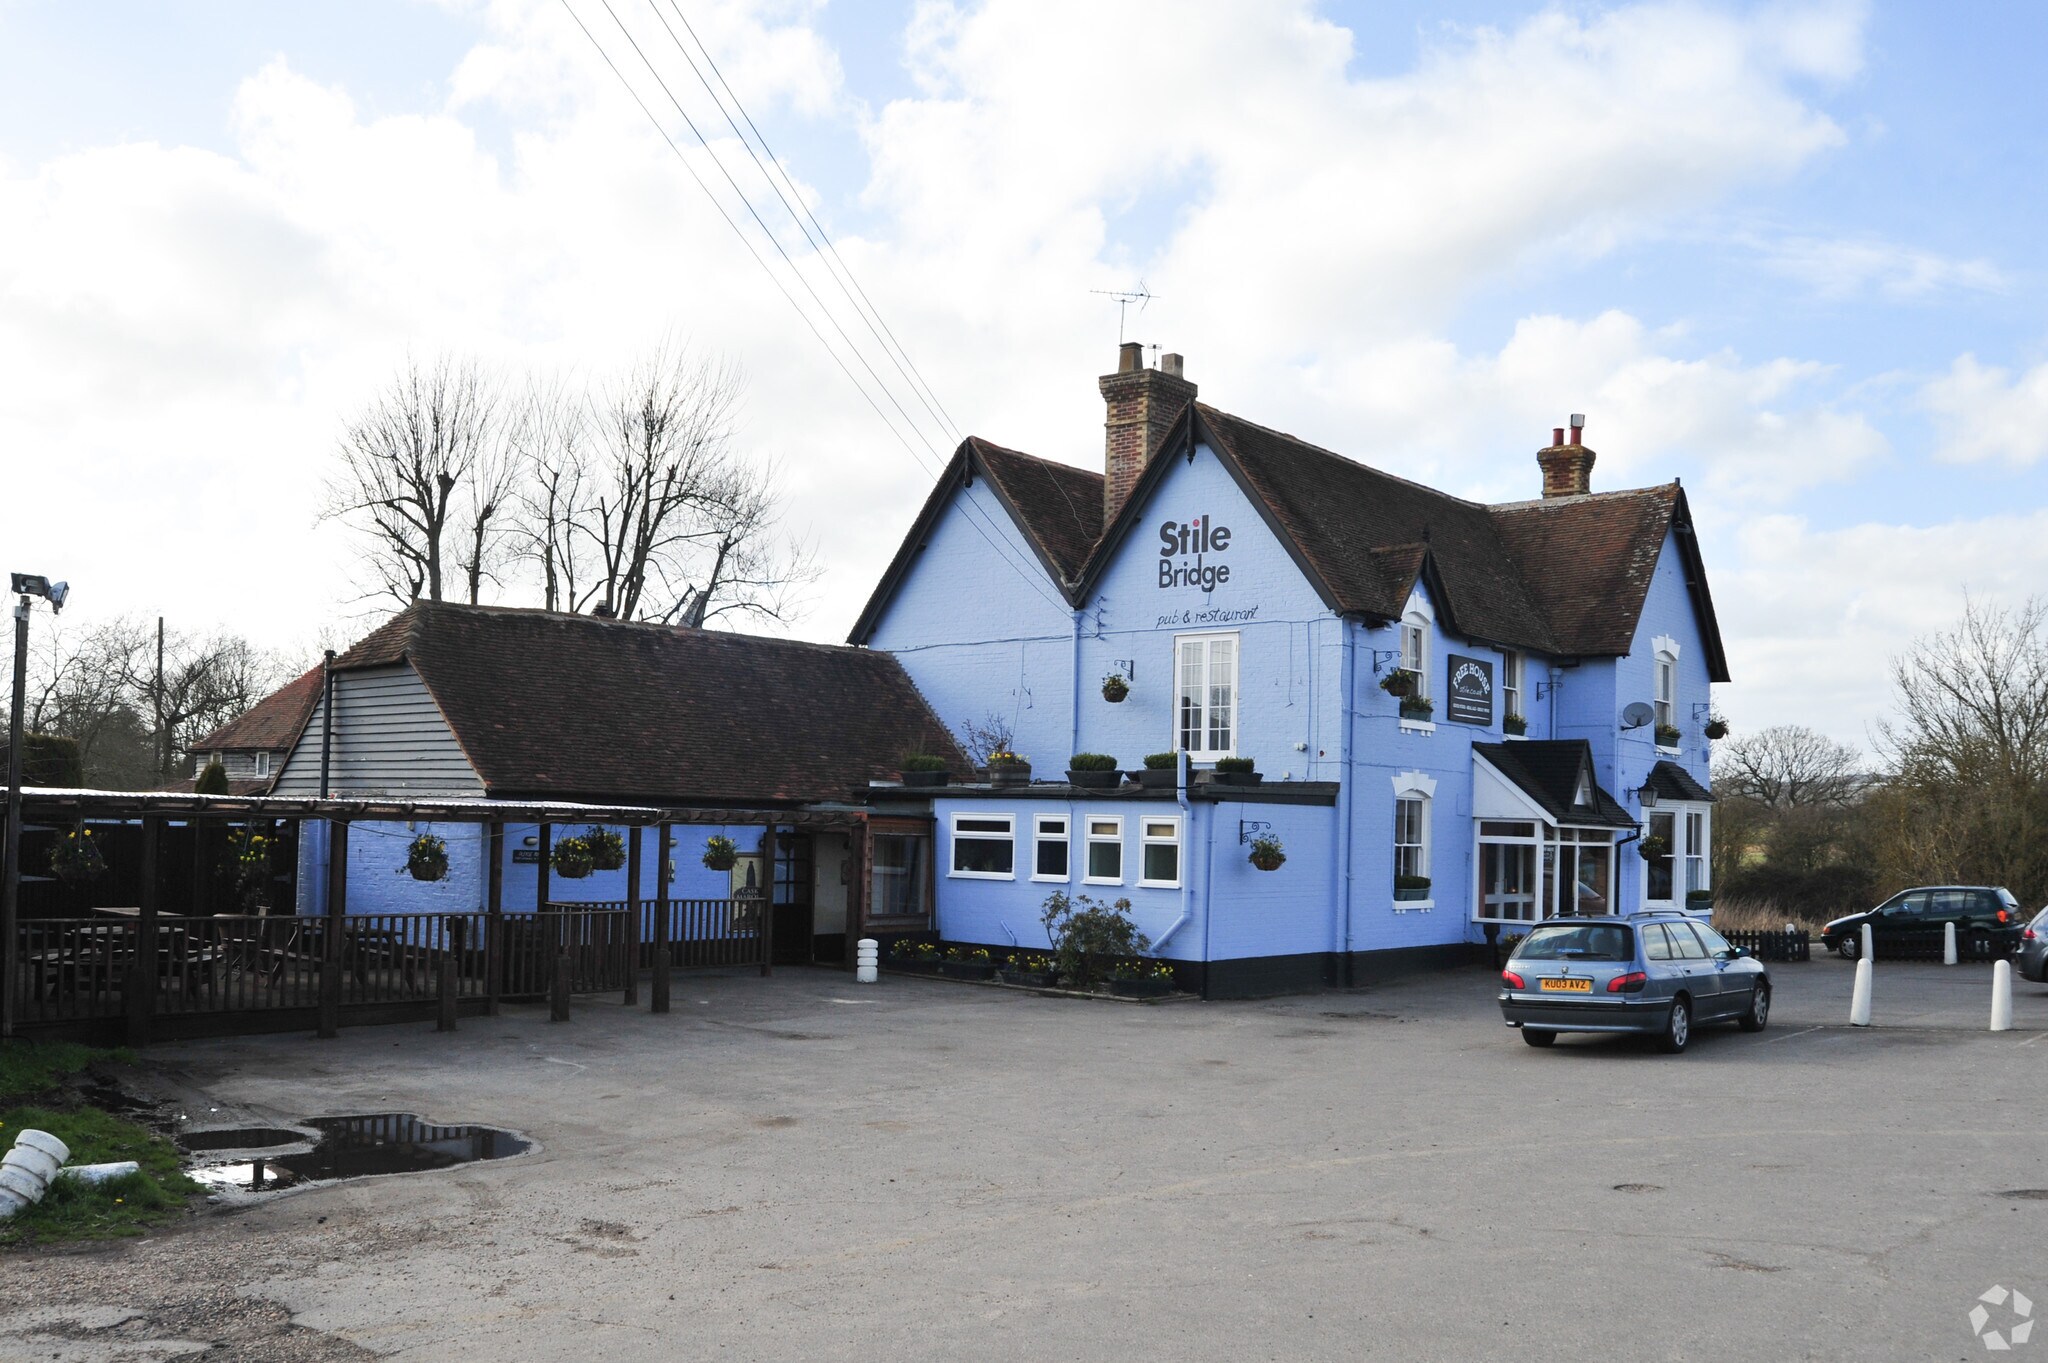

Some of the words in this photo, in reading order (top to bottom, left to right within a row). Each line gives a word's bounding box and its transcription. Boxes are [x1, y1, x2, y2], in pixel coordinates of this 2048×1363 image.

[1160, 515, 1231, 557] Stile
[1159, 554, 1230, 592] Bridge
[1156, 610, 1178, 628] pub
[1183, 610, 1191, 623] &
[1195, 605, 1258, 622] restaurant
[1453, 663, 1468, 689] FREE
[1469, 663, 1490, 694] HOUSE
[1545, 979, 1567, 989] KU03
[1569, 980, 1586, 989] AVZ
